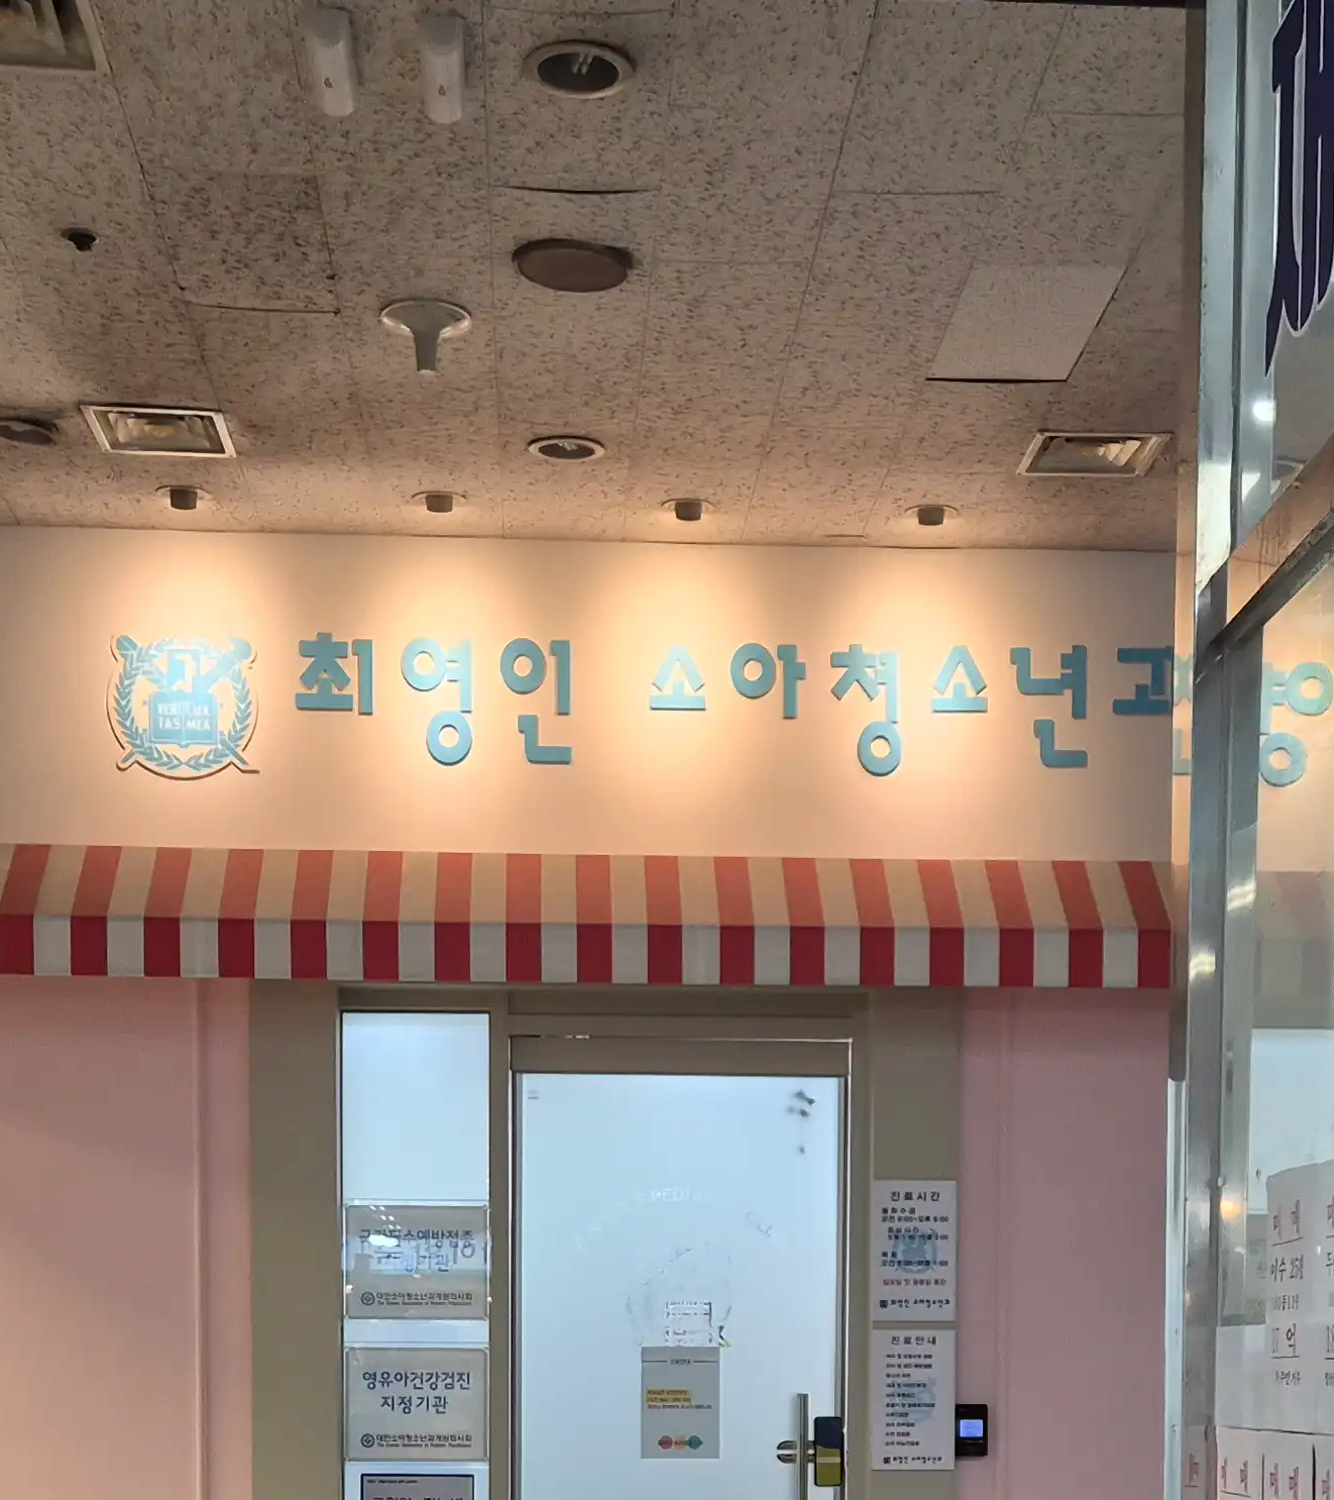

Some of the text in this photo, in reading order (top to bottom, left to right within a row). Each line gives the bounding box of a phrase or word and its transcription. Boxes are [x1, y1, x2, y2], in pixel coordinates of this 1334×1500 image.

[295, 633, 573, 766] 최영인
[362, 1371, 471, 1391] 영유아건강검진
[380, 1396, 449, 1415] 지정기관
